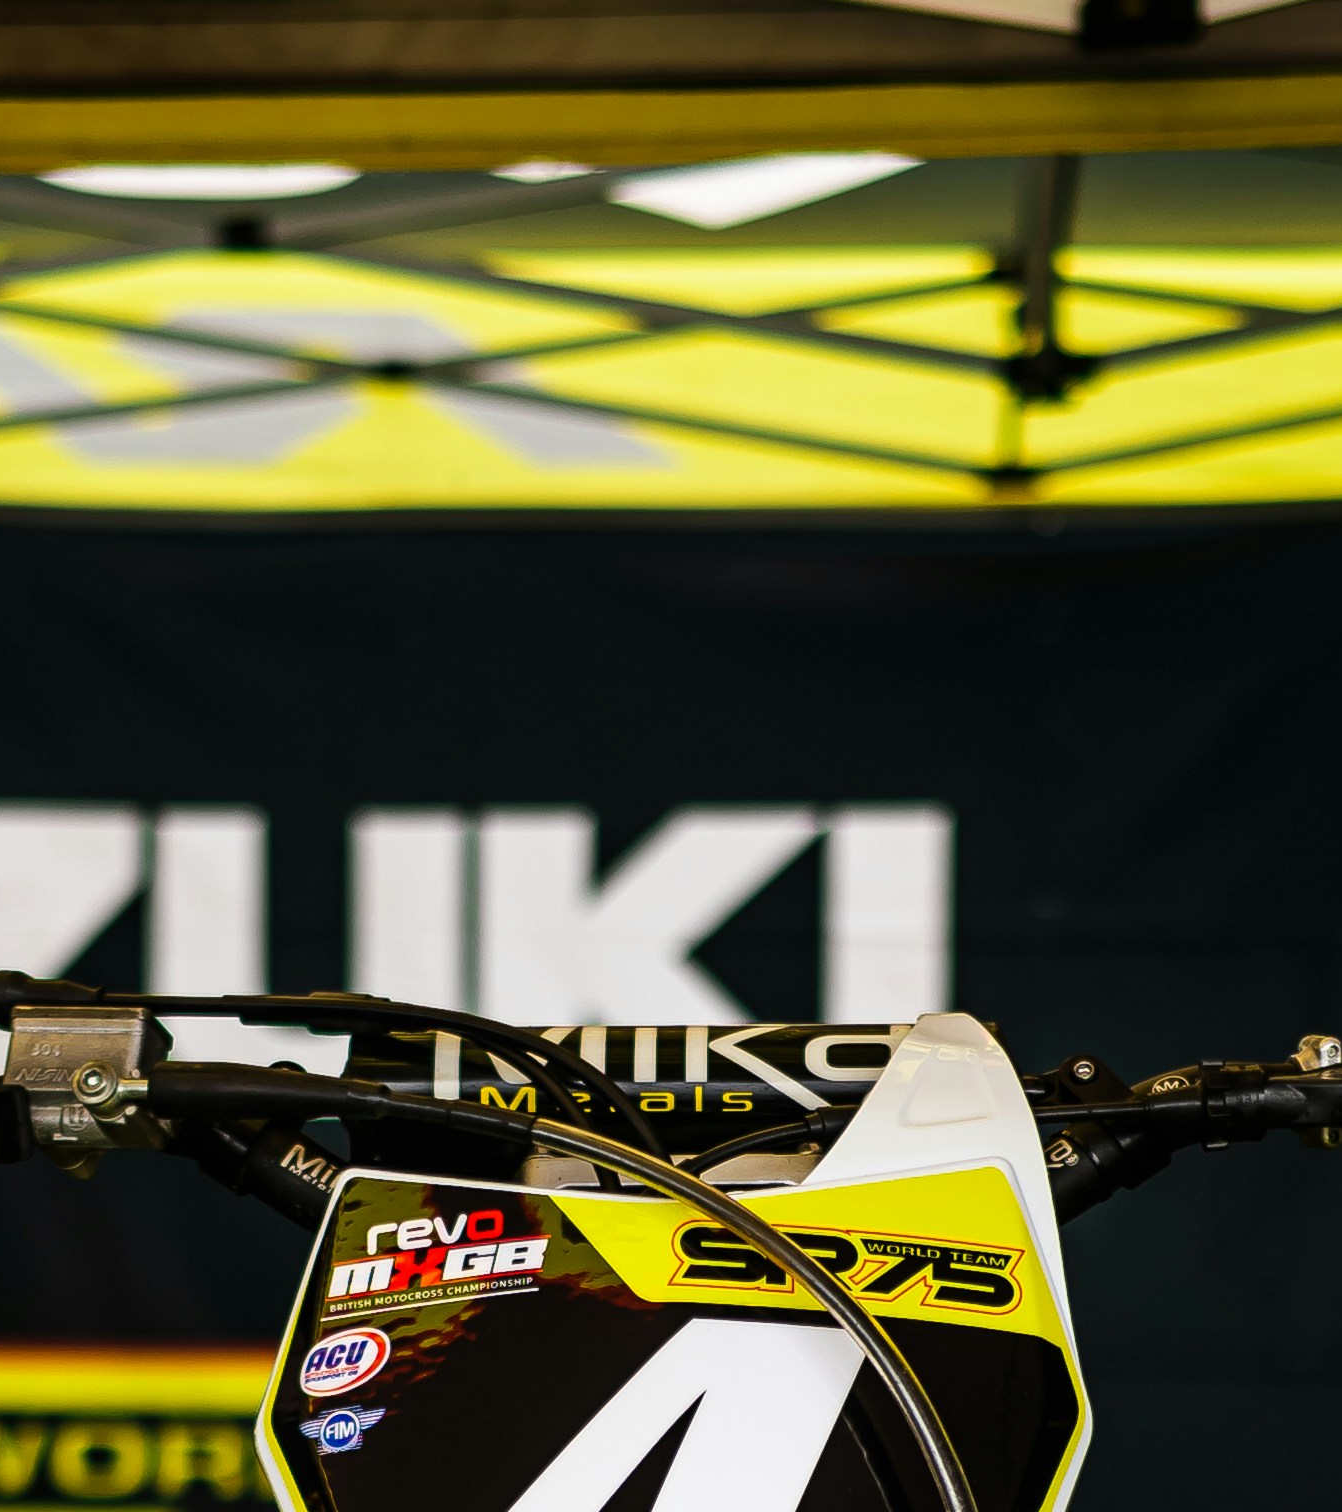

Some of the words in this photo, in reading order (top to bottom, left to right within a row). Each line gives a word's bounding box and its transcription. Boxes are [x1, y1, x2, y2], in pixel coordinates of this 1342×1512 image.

[367, 1210, 504, 1255] revo
[866, 1242, 941, 1260] WORLD
[949, 1250, 1006, 1268] TEAM
[329, 1298, 372, 1313] BRITISH
[374, 1287, 444, 1307] MOTOCROSS
[446, 1276, 534, 1296] CHAMPIONSHIP
[304, 1340, 369, 1374] ACU
[326, 1421, 355, 1440] FIM
